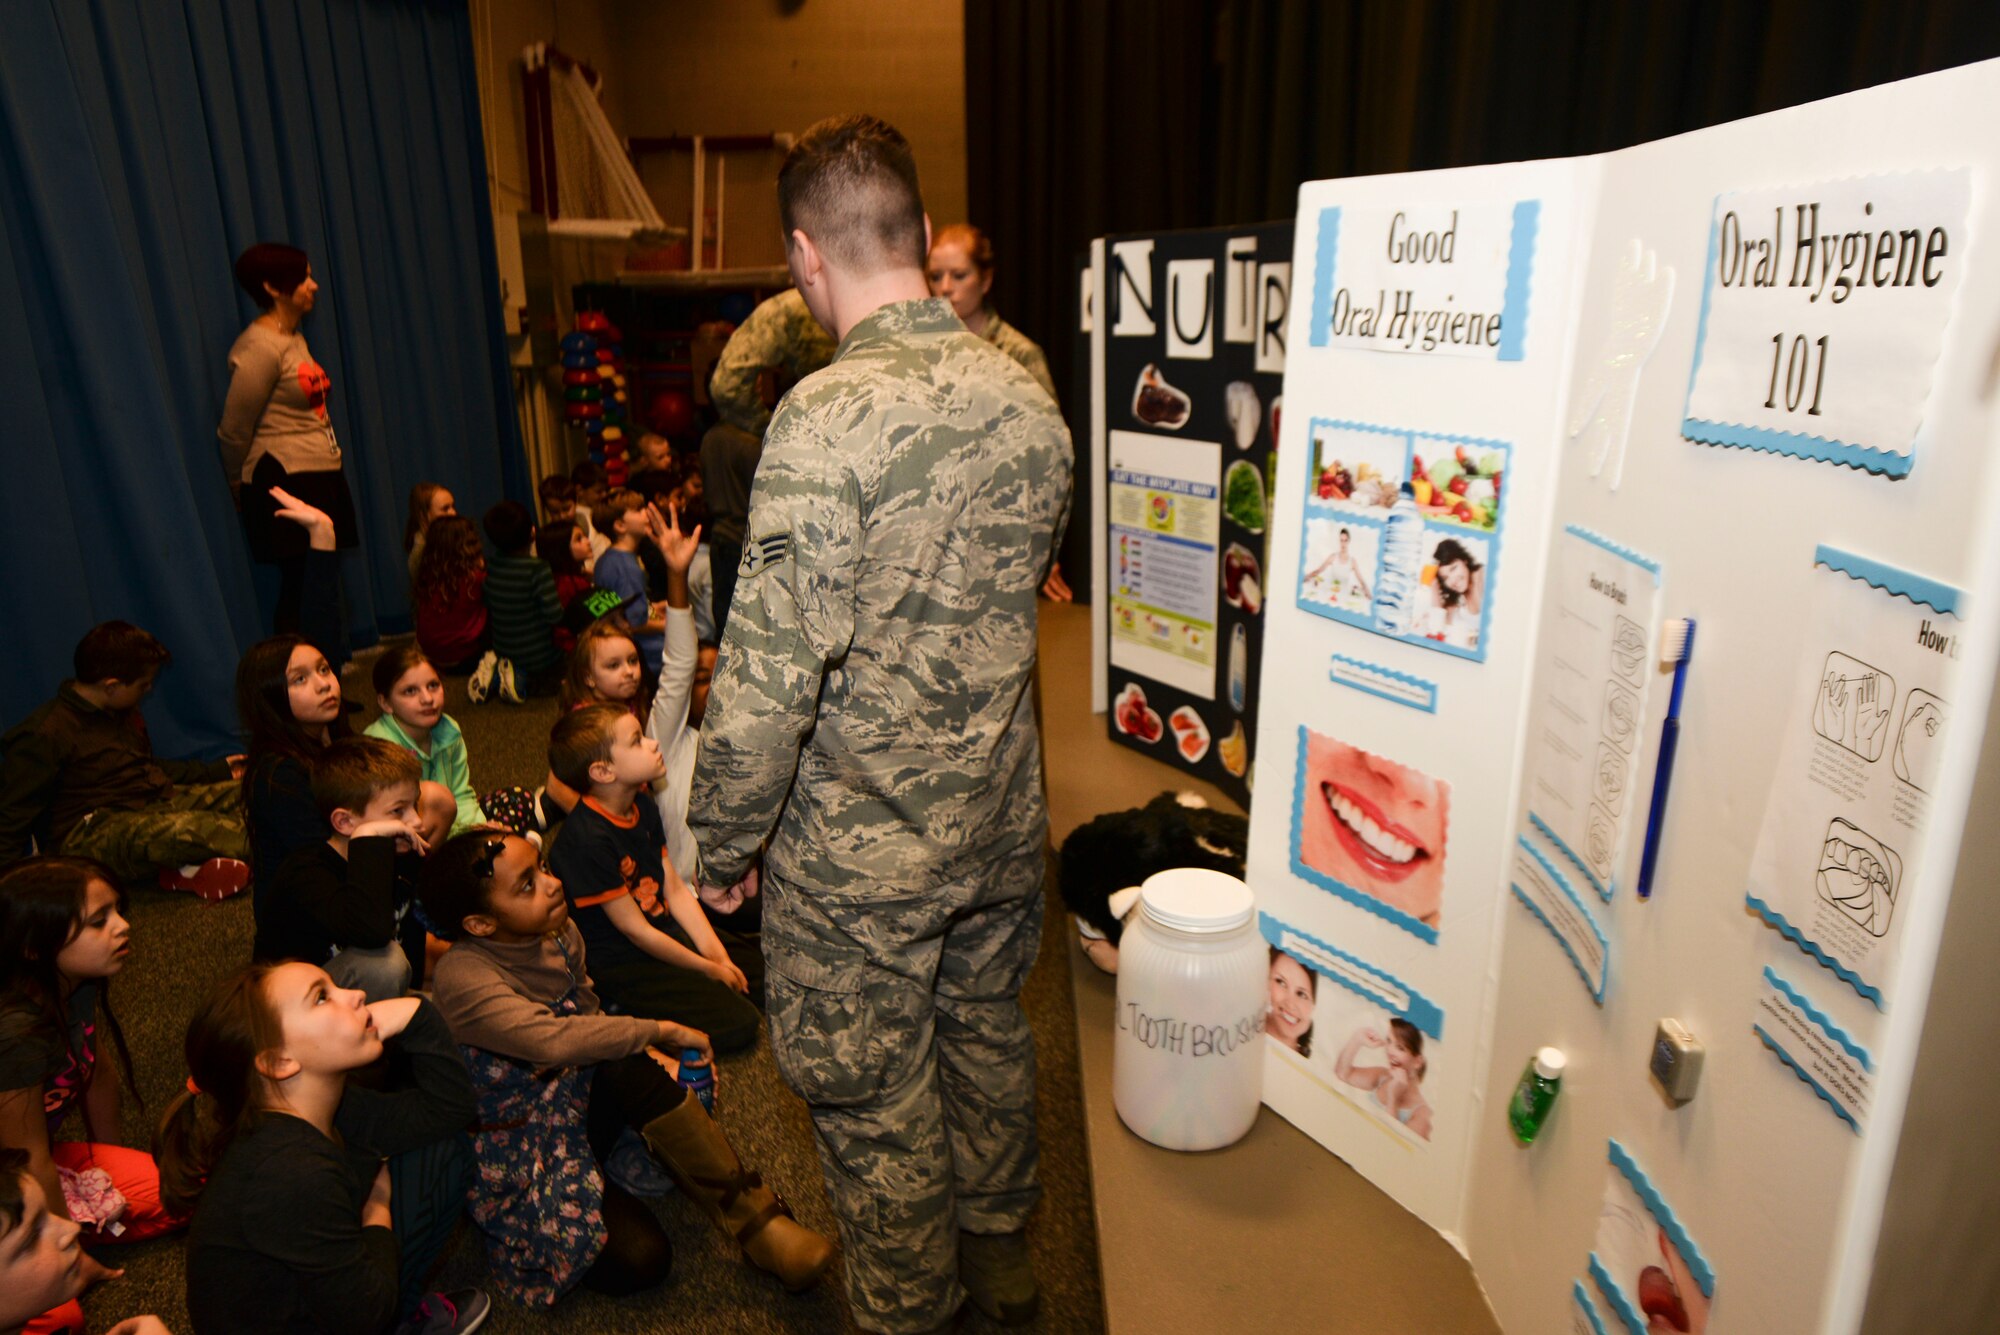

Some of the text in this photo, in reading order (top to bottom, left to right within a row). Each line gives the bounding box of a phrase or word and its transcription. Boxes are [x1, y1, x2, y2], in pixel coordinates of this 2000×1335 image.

[1387, 210, 1459, 264] Good
[1720, 202, 1948, 304] Oral Hygiene
[1331, 288, 1502, 352] Oral Hygiene
[1764, 331, 1830, 416] 101
[1917, 619, 1949, 655] How
